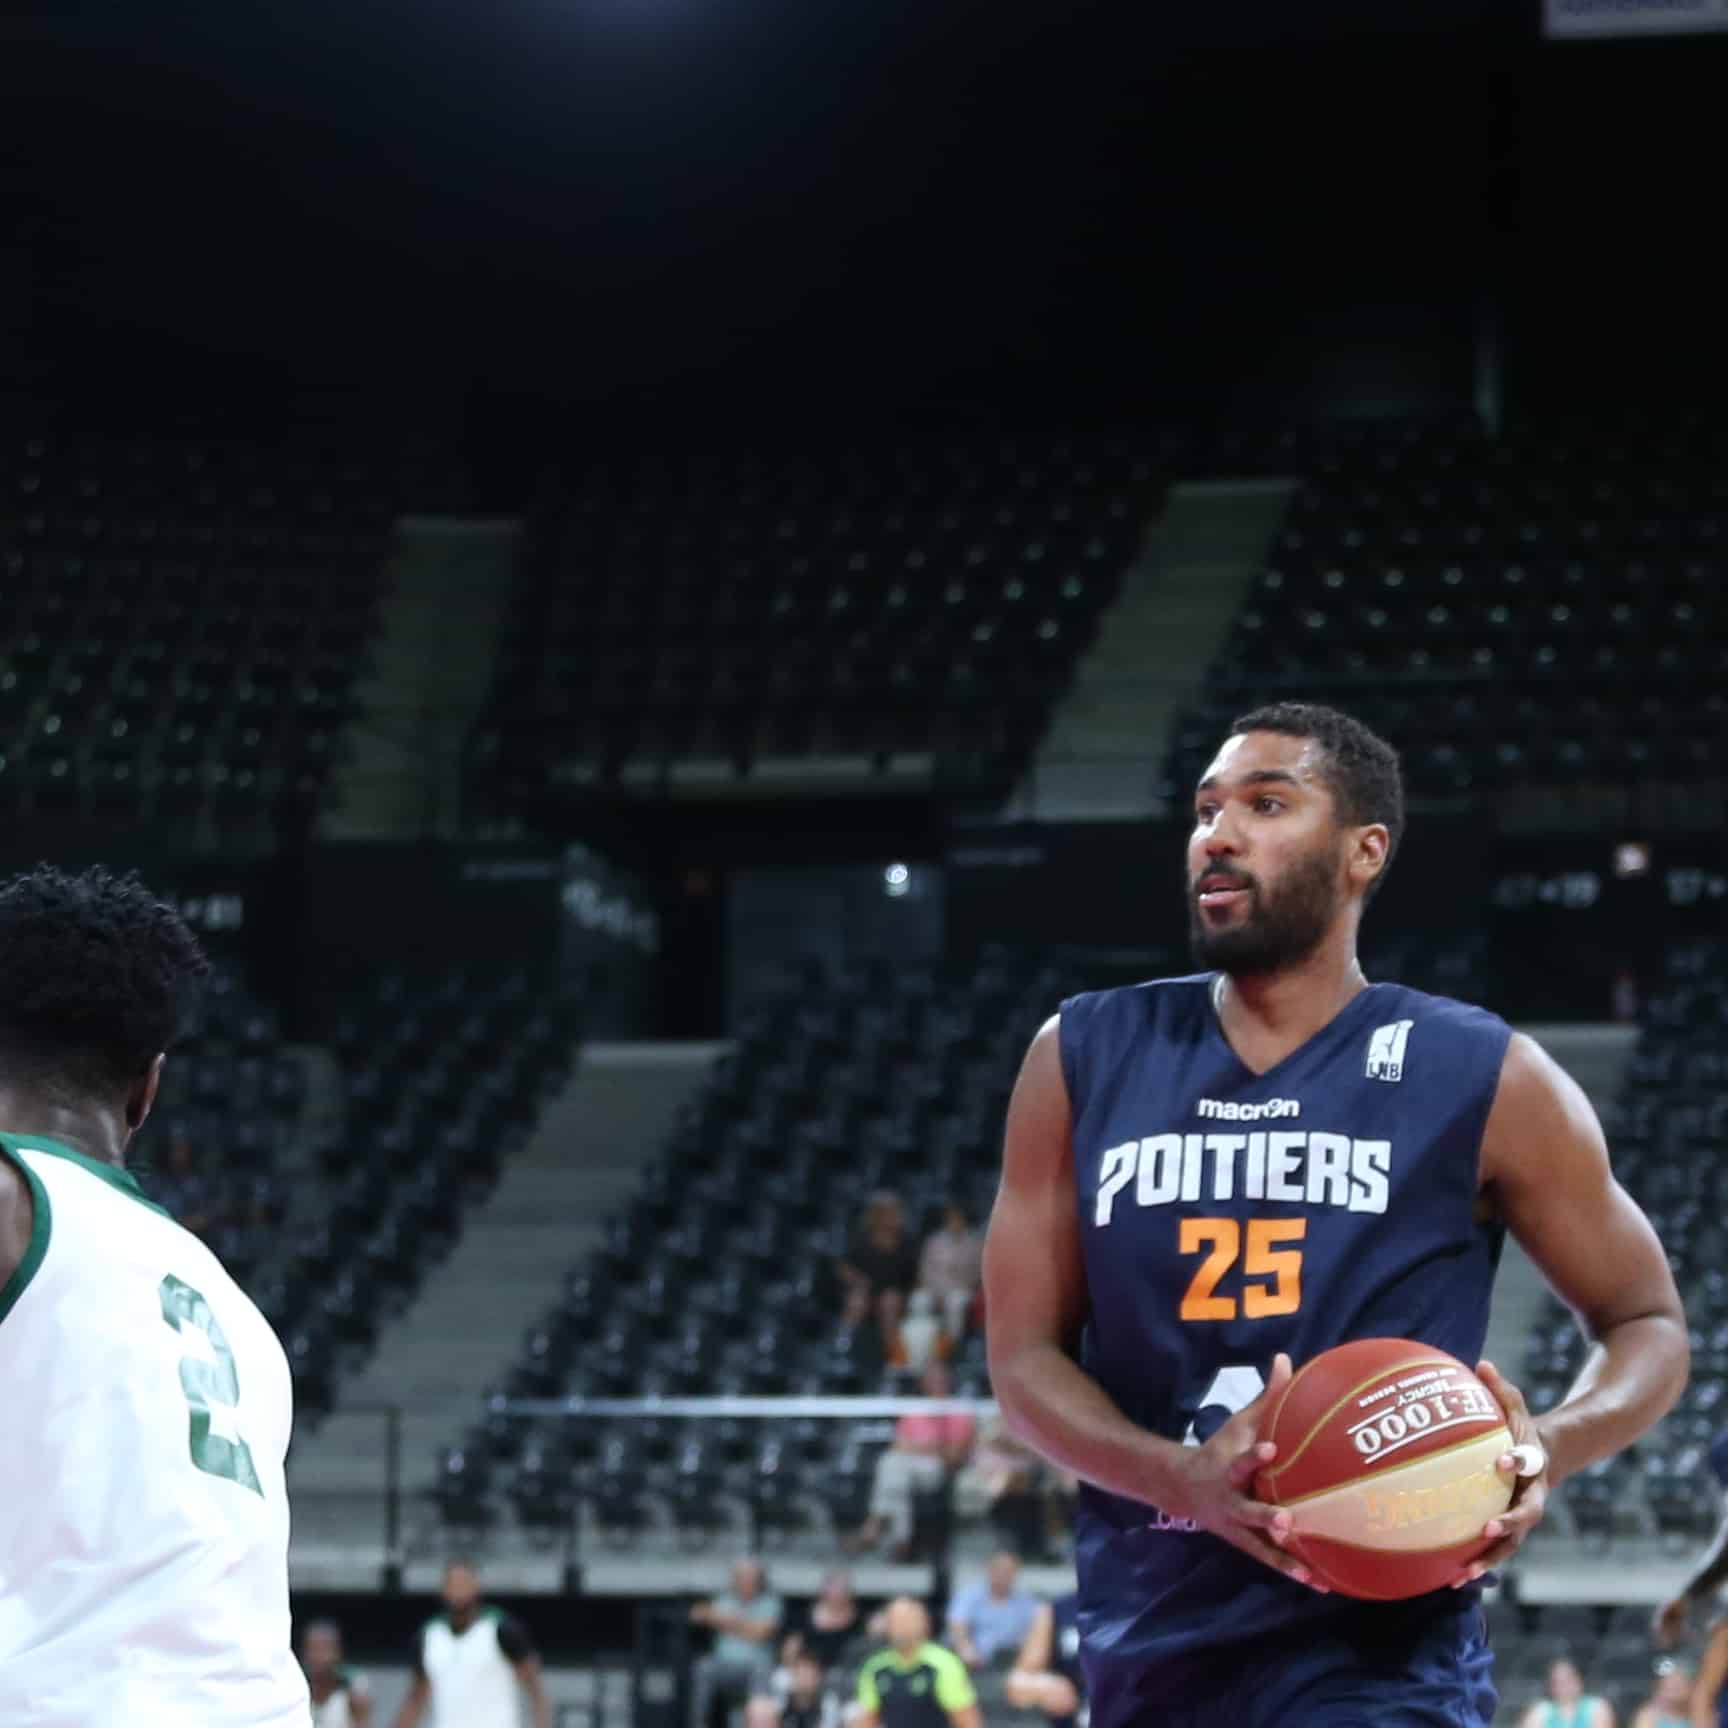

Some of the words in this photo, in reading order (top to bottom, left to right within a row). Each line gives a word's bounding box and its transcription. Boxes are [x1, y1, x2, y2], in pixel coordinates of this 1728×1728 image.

[1196, 1098, 1300, 1121] macron
[1094, 1131, 1392, 1228] POITIERS
[1179, 1216, 1307, 1321] 25
[159, 1273, 265, 1499] 2
